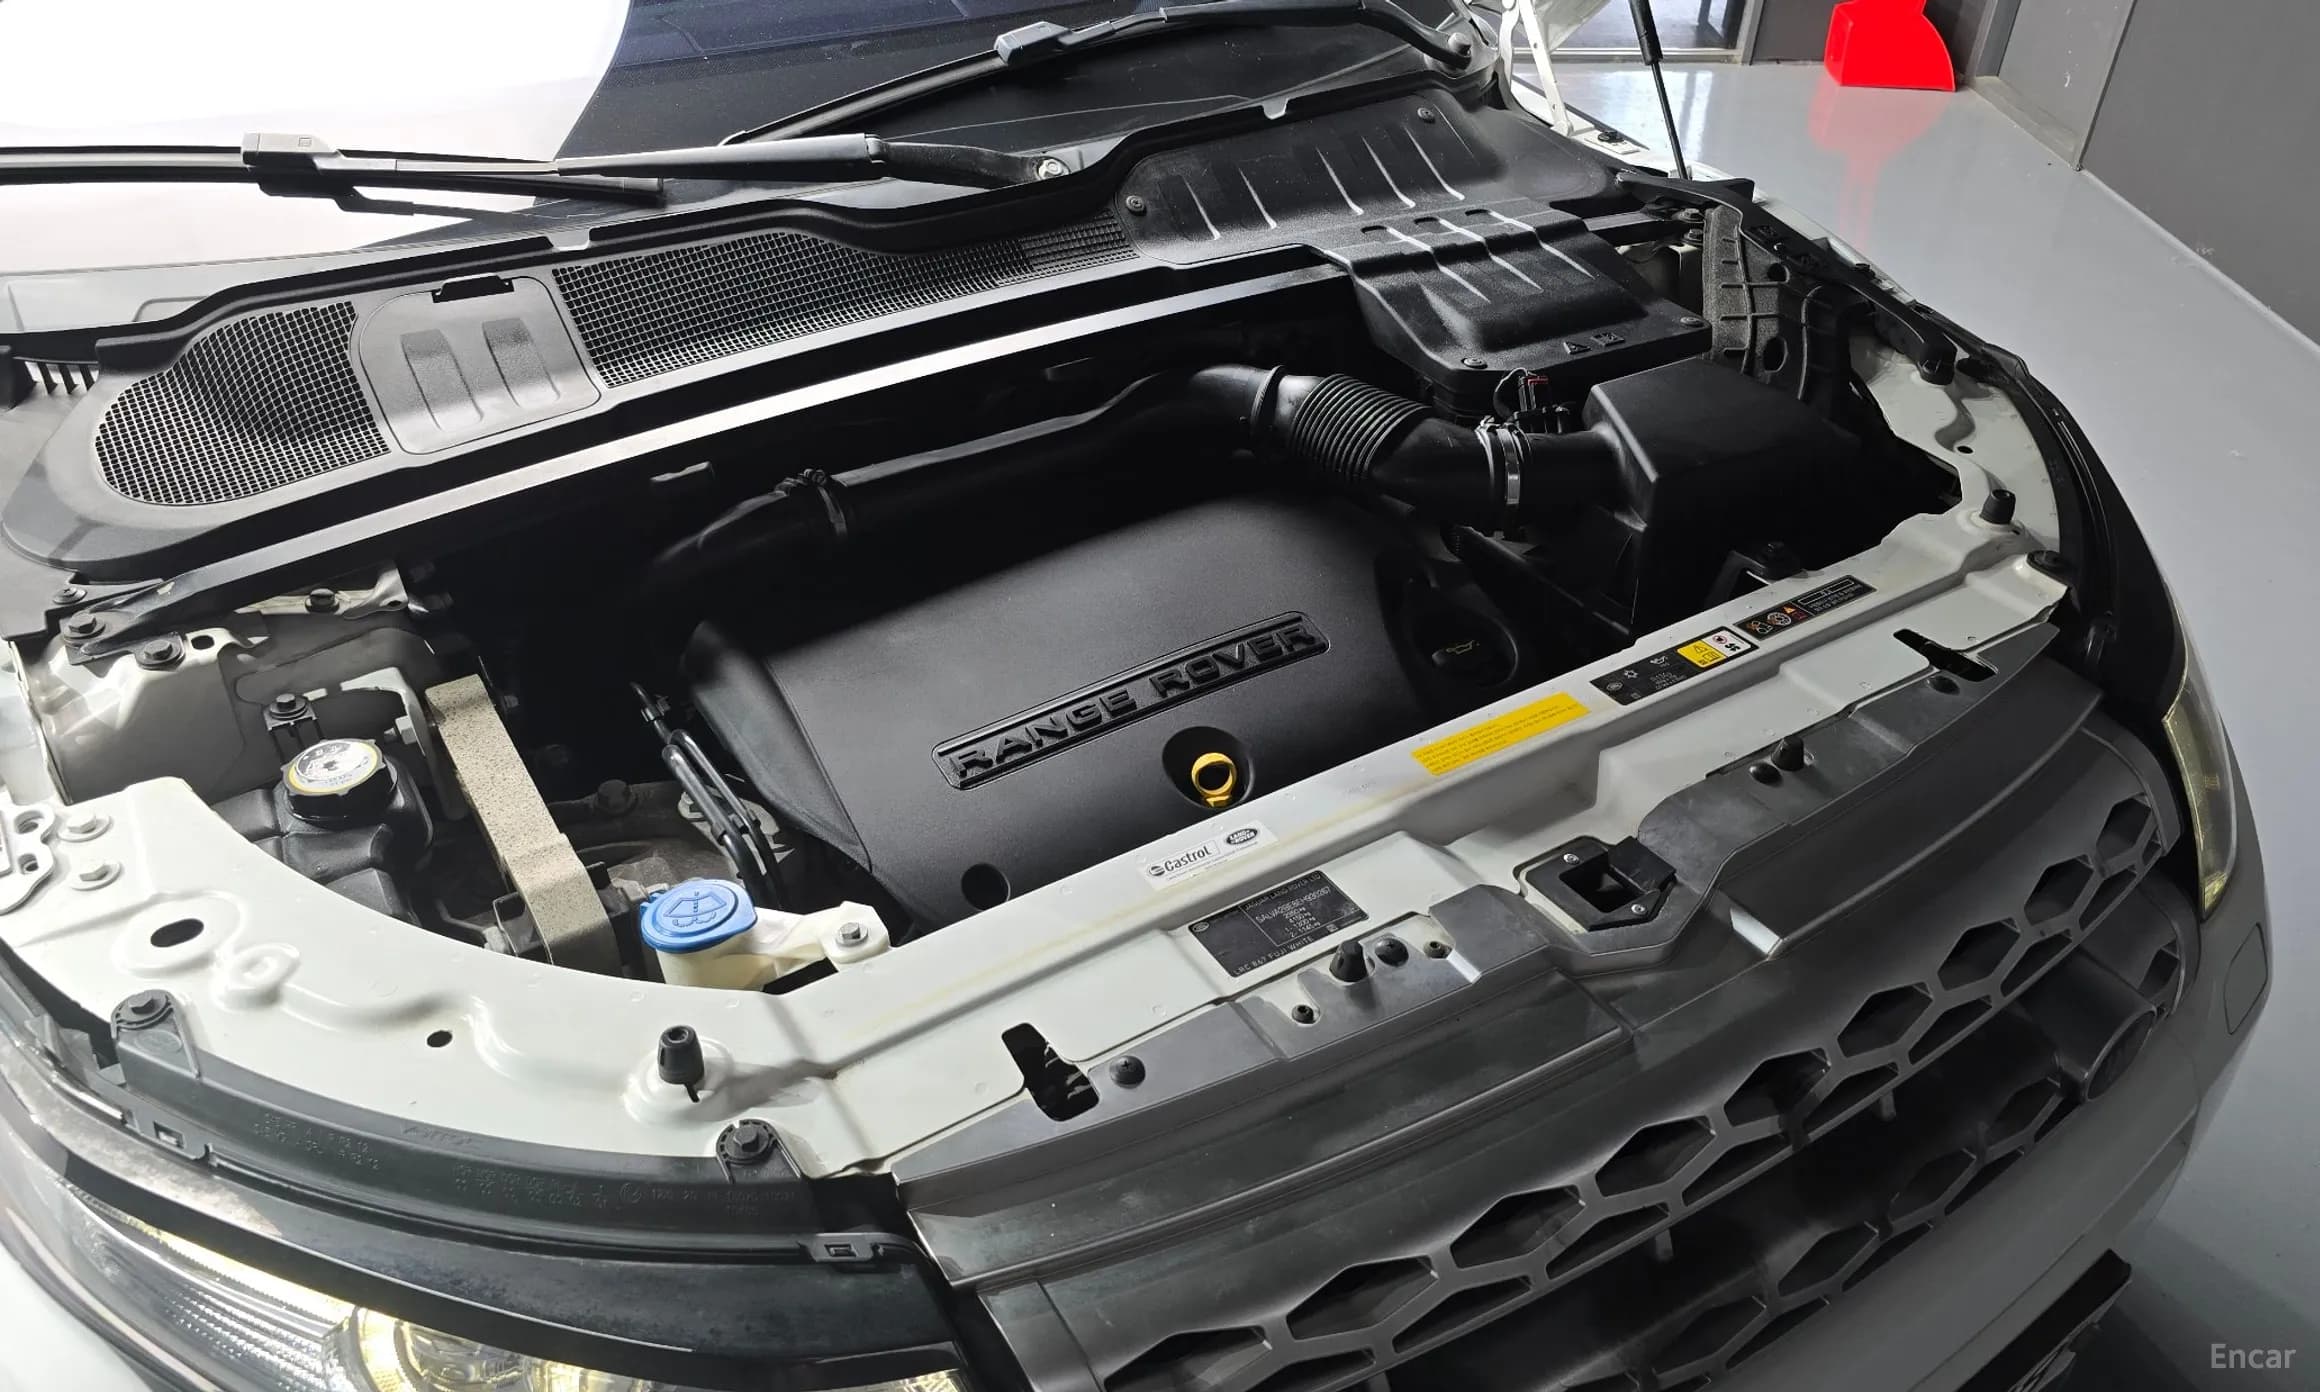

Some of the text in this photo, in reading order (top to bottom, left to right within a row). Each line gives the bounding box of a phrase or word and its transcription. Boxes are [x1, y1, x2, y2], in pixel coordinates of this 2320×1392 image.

[950, 624, 1317, 778] RANGE ROVER
[1164, 845, 1212, 873] Castrol
[1268, 947, 1287, 960] FUJI
[1288, 936, 1314, 950] WHITE
